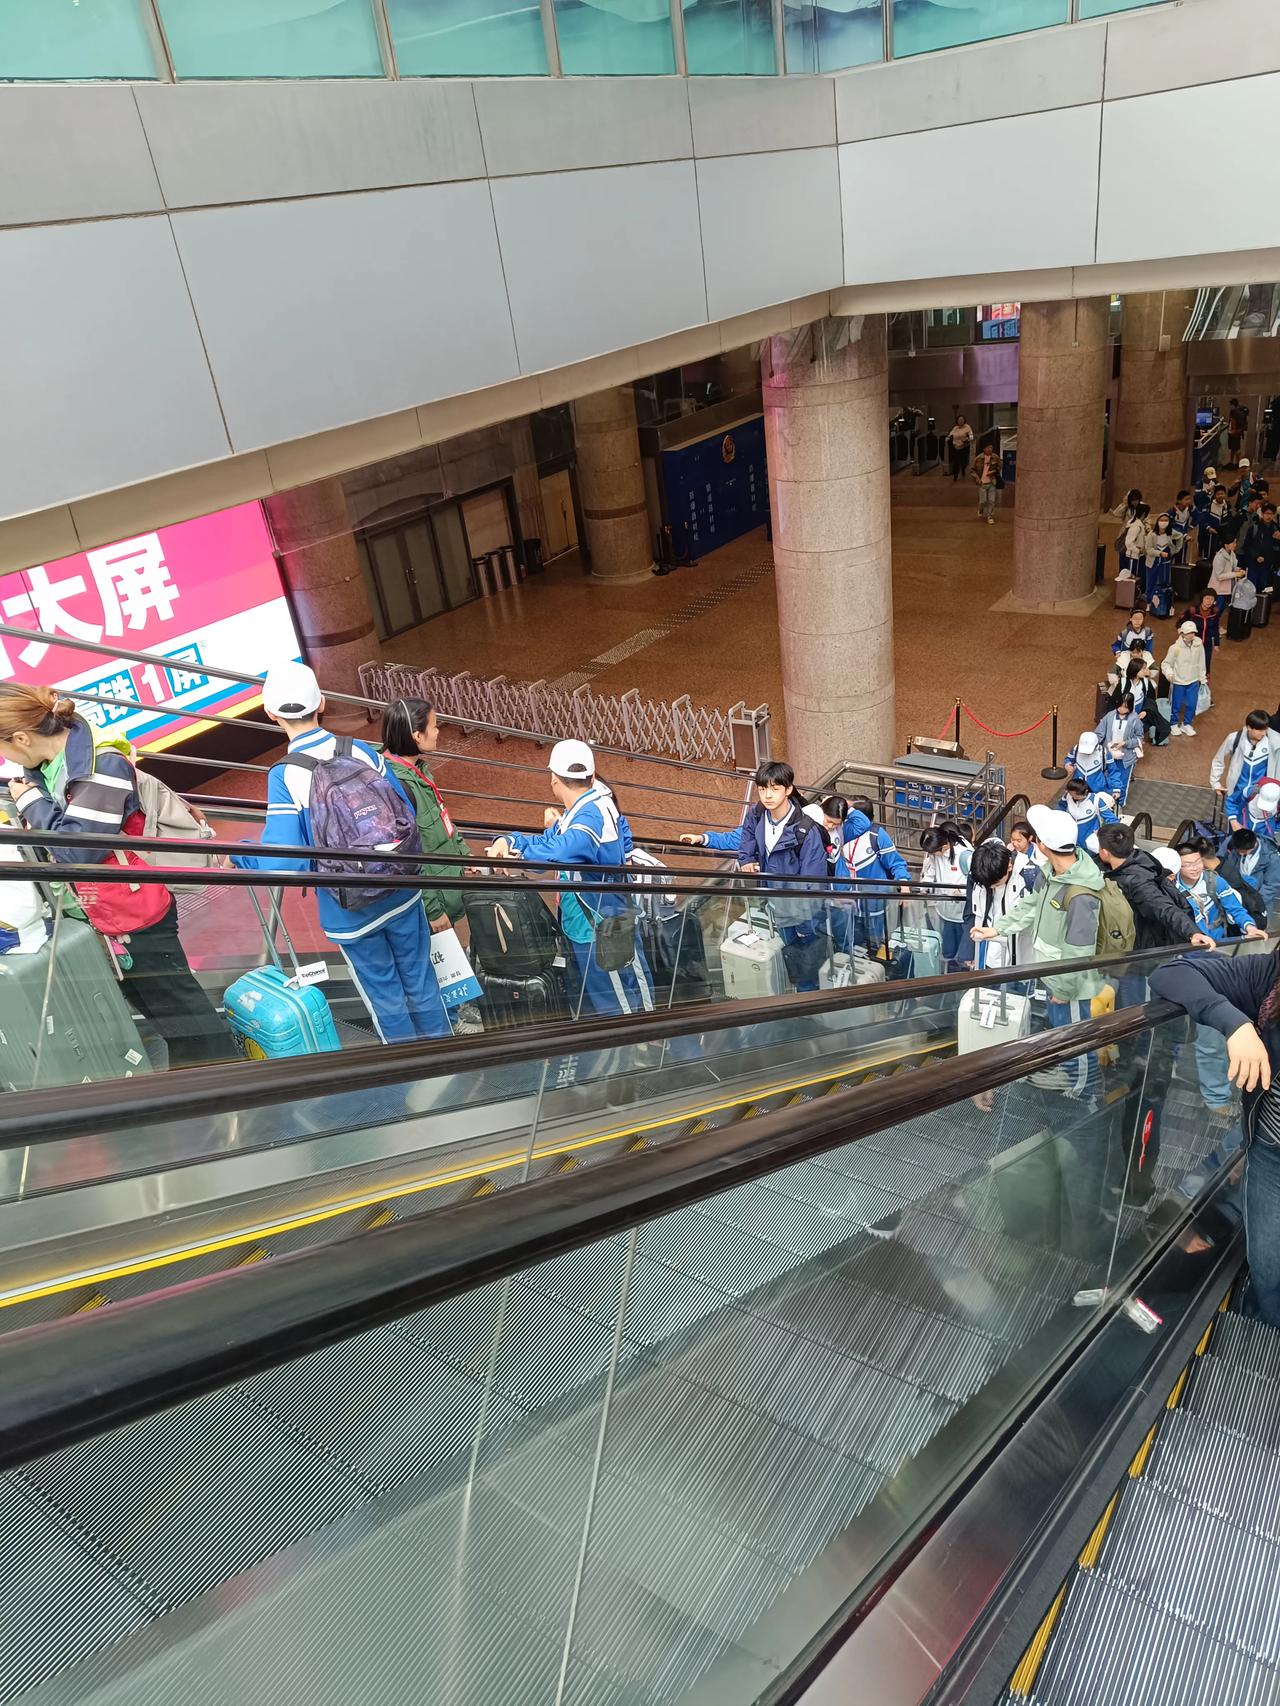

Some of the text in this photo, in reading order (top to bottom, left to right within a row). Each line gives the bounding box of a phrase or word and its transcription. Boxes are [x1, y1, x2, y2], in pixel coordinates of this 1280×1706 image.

[0, 531, 181, 682] 大屏
[72, 646, 203, 727] 高铁1屏
